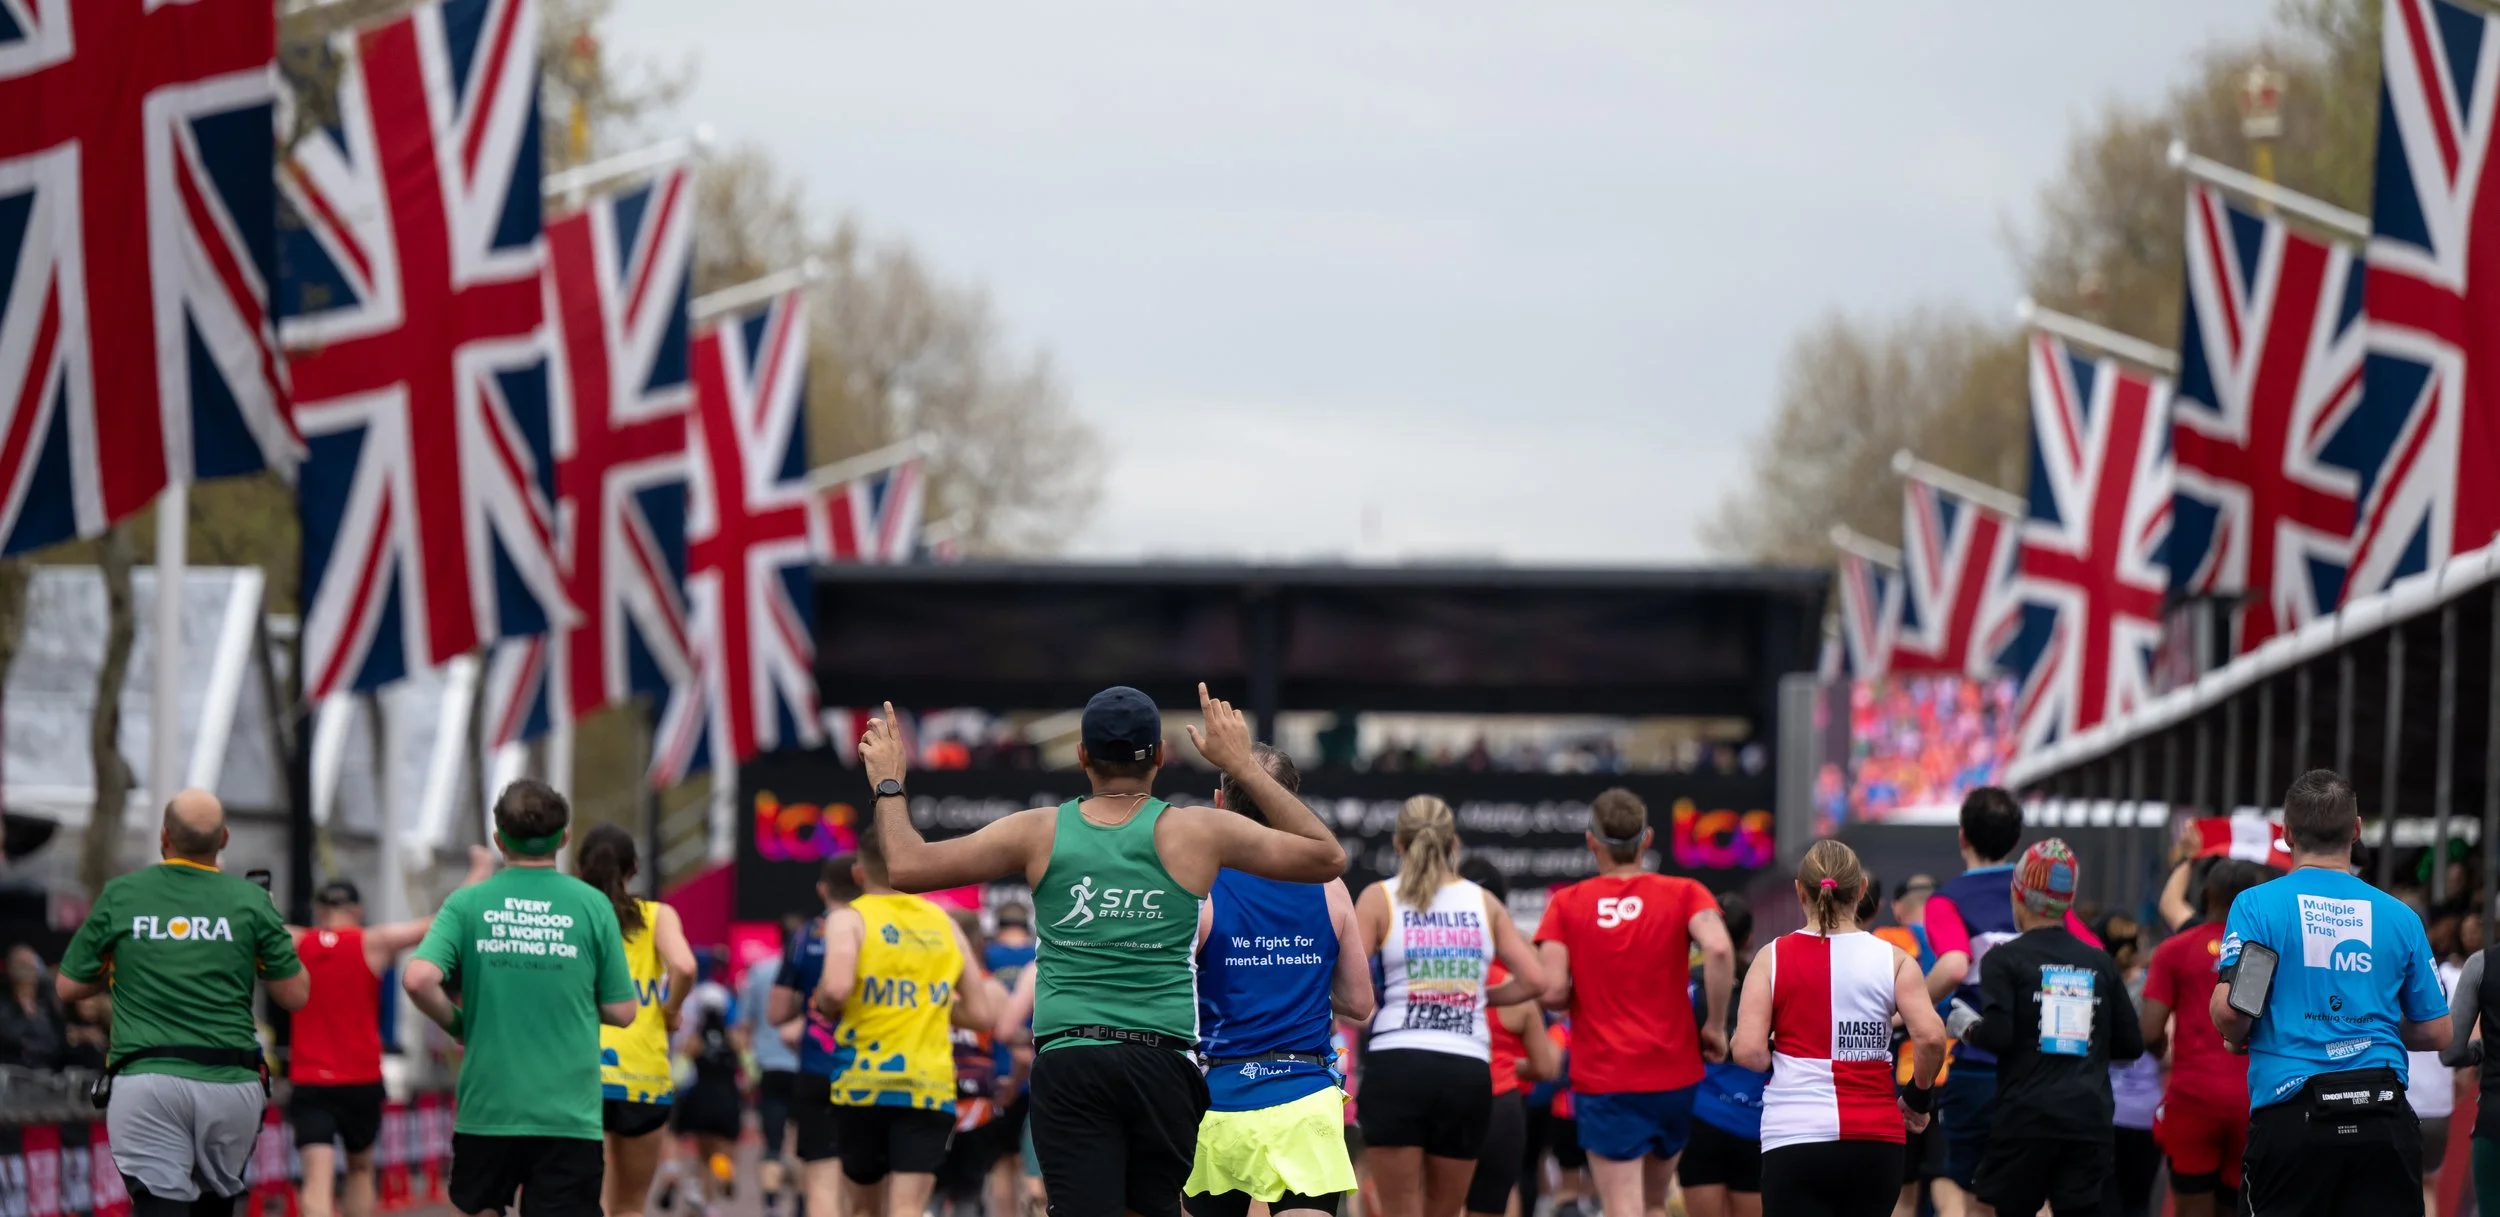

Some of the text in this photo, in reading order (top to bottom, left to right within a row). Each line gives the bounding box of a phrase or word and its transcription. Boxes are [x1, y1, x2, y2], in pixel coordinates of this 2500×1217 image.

[504, 897, 552, 913] EVERY
[1596, 895, 1644, 928] 50
[2303, 900, 2355, 916] Multiple
[483, 910, 574, 928] CHILDHOOD
[1099, 910, 1164, 919] BRISTOL
[1403, 911, 1480, 928] FAMILIES
[2304, 910, 2364, 927] Sclerosis
[133, 915, 233, 941] FLORA
[492, 924, 564, 942] IS WORTH
[2306, 923, 2337, 938] Trust
[1231, 935, 1314, 951] We fight for
[1403, 928, 1483, 947] FRIENDS
[476, 939, 578, 959] FIGHTING FOR
[1225, 953, 1322, 966] mental health
[2335, 952, 2372, 973] MS
[1407, 959, 1480, 979] CARERS
[861, 975, 918, 1008] MR
[2342, 1015, 2375, 1024] triders
[1838, 1021, 1887, 1036] MASSEY
[1838, 1036, 1887, 1049] RUNNERS
[1838, 1050, 1887, 1062] COVENTRY
[2322, 1090, 2371, 1101] LONDON MARATHON
